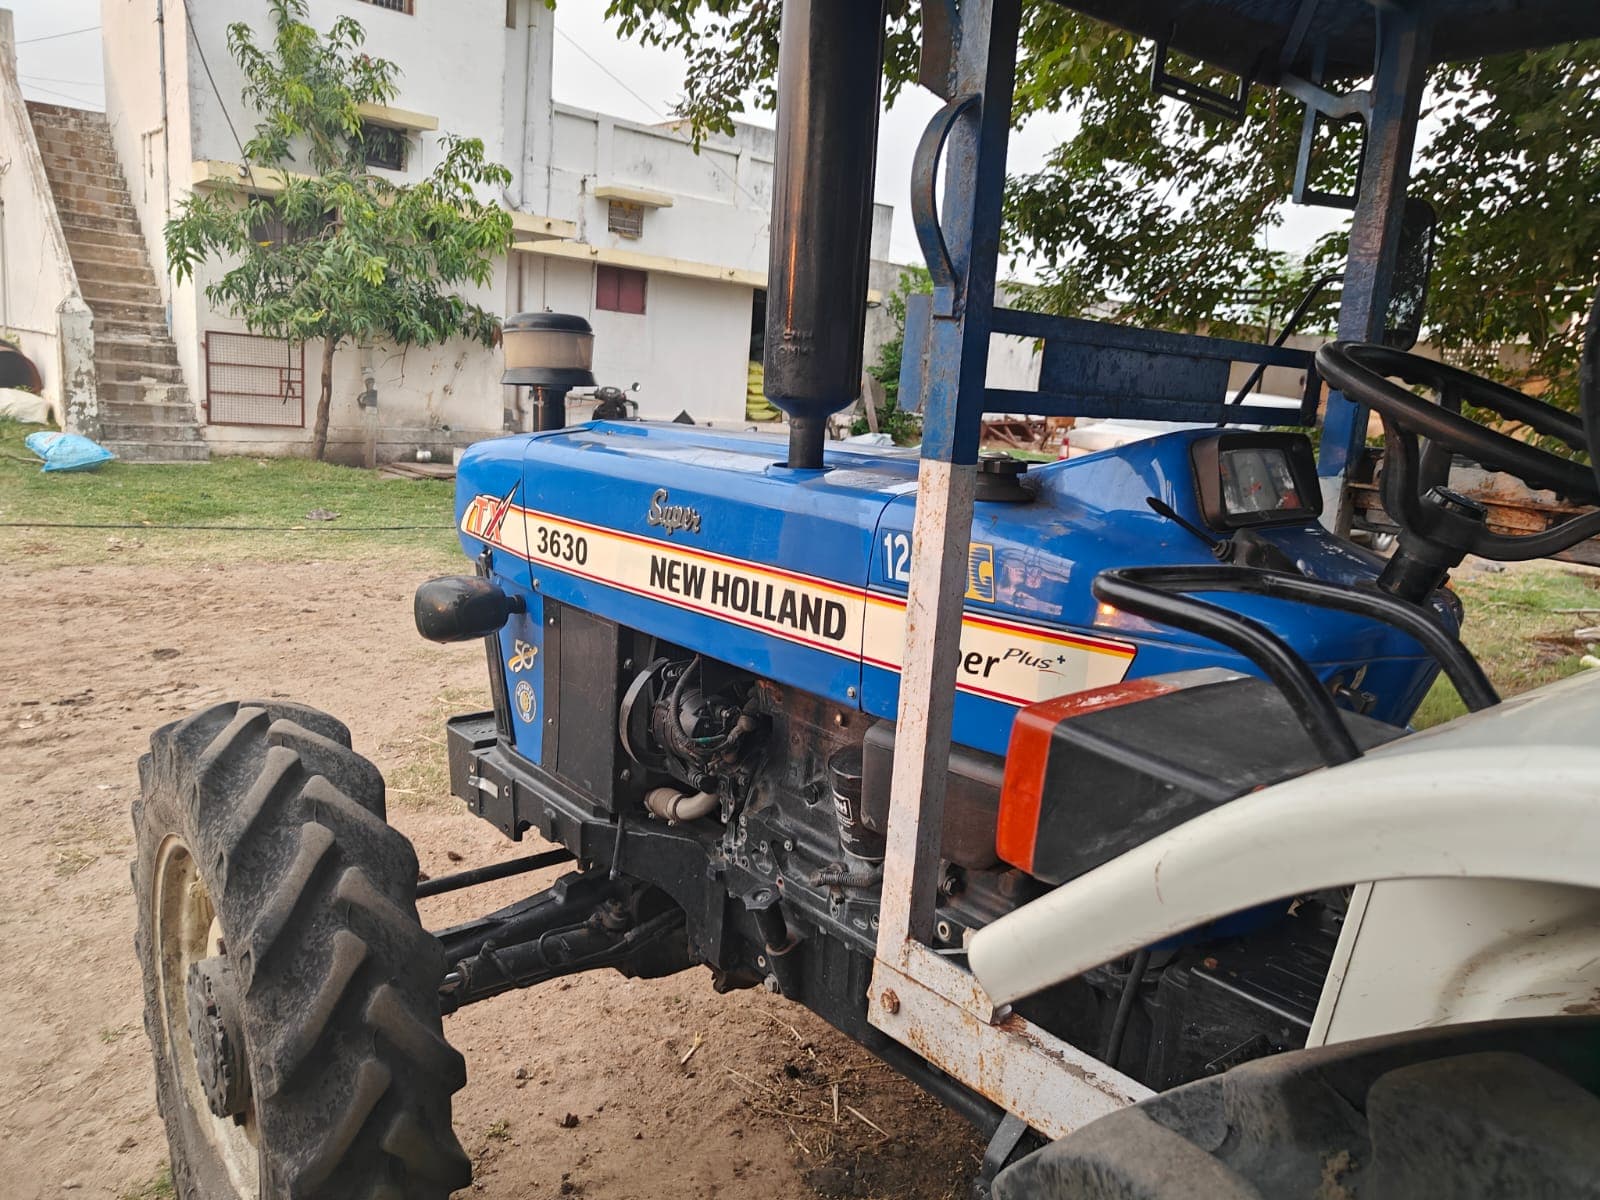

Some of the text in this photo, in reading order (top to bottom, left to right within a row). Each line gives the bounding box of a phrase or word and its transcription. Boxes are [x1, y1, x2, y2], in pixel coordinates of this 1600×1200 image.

[469, 485, 515, 543] TX
[647, 487, 702, 535] Super
[535, 526, 588, 568] 3630
[884, 532, 912, 583] 12
[649, 555, 847, 641] NEW HOLLAND
[955, 650, 1001, 678] er
